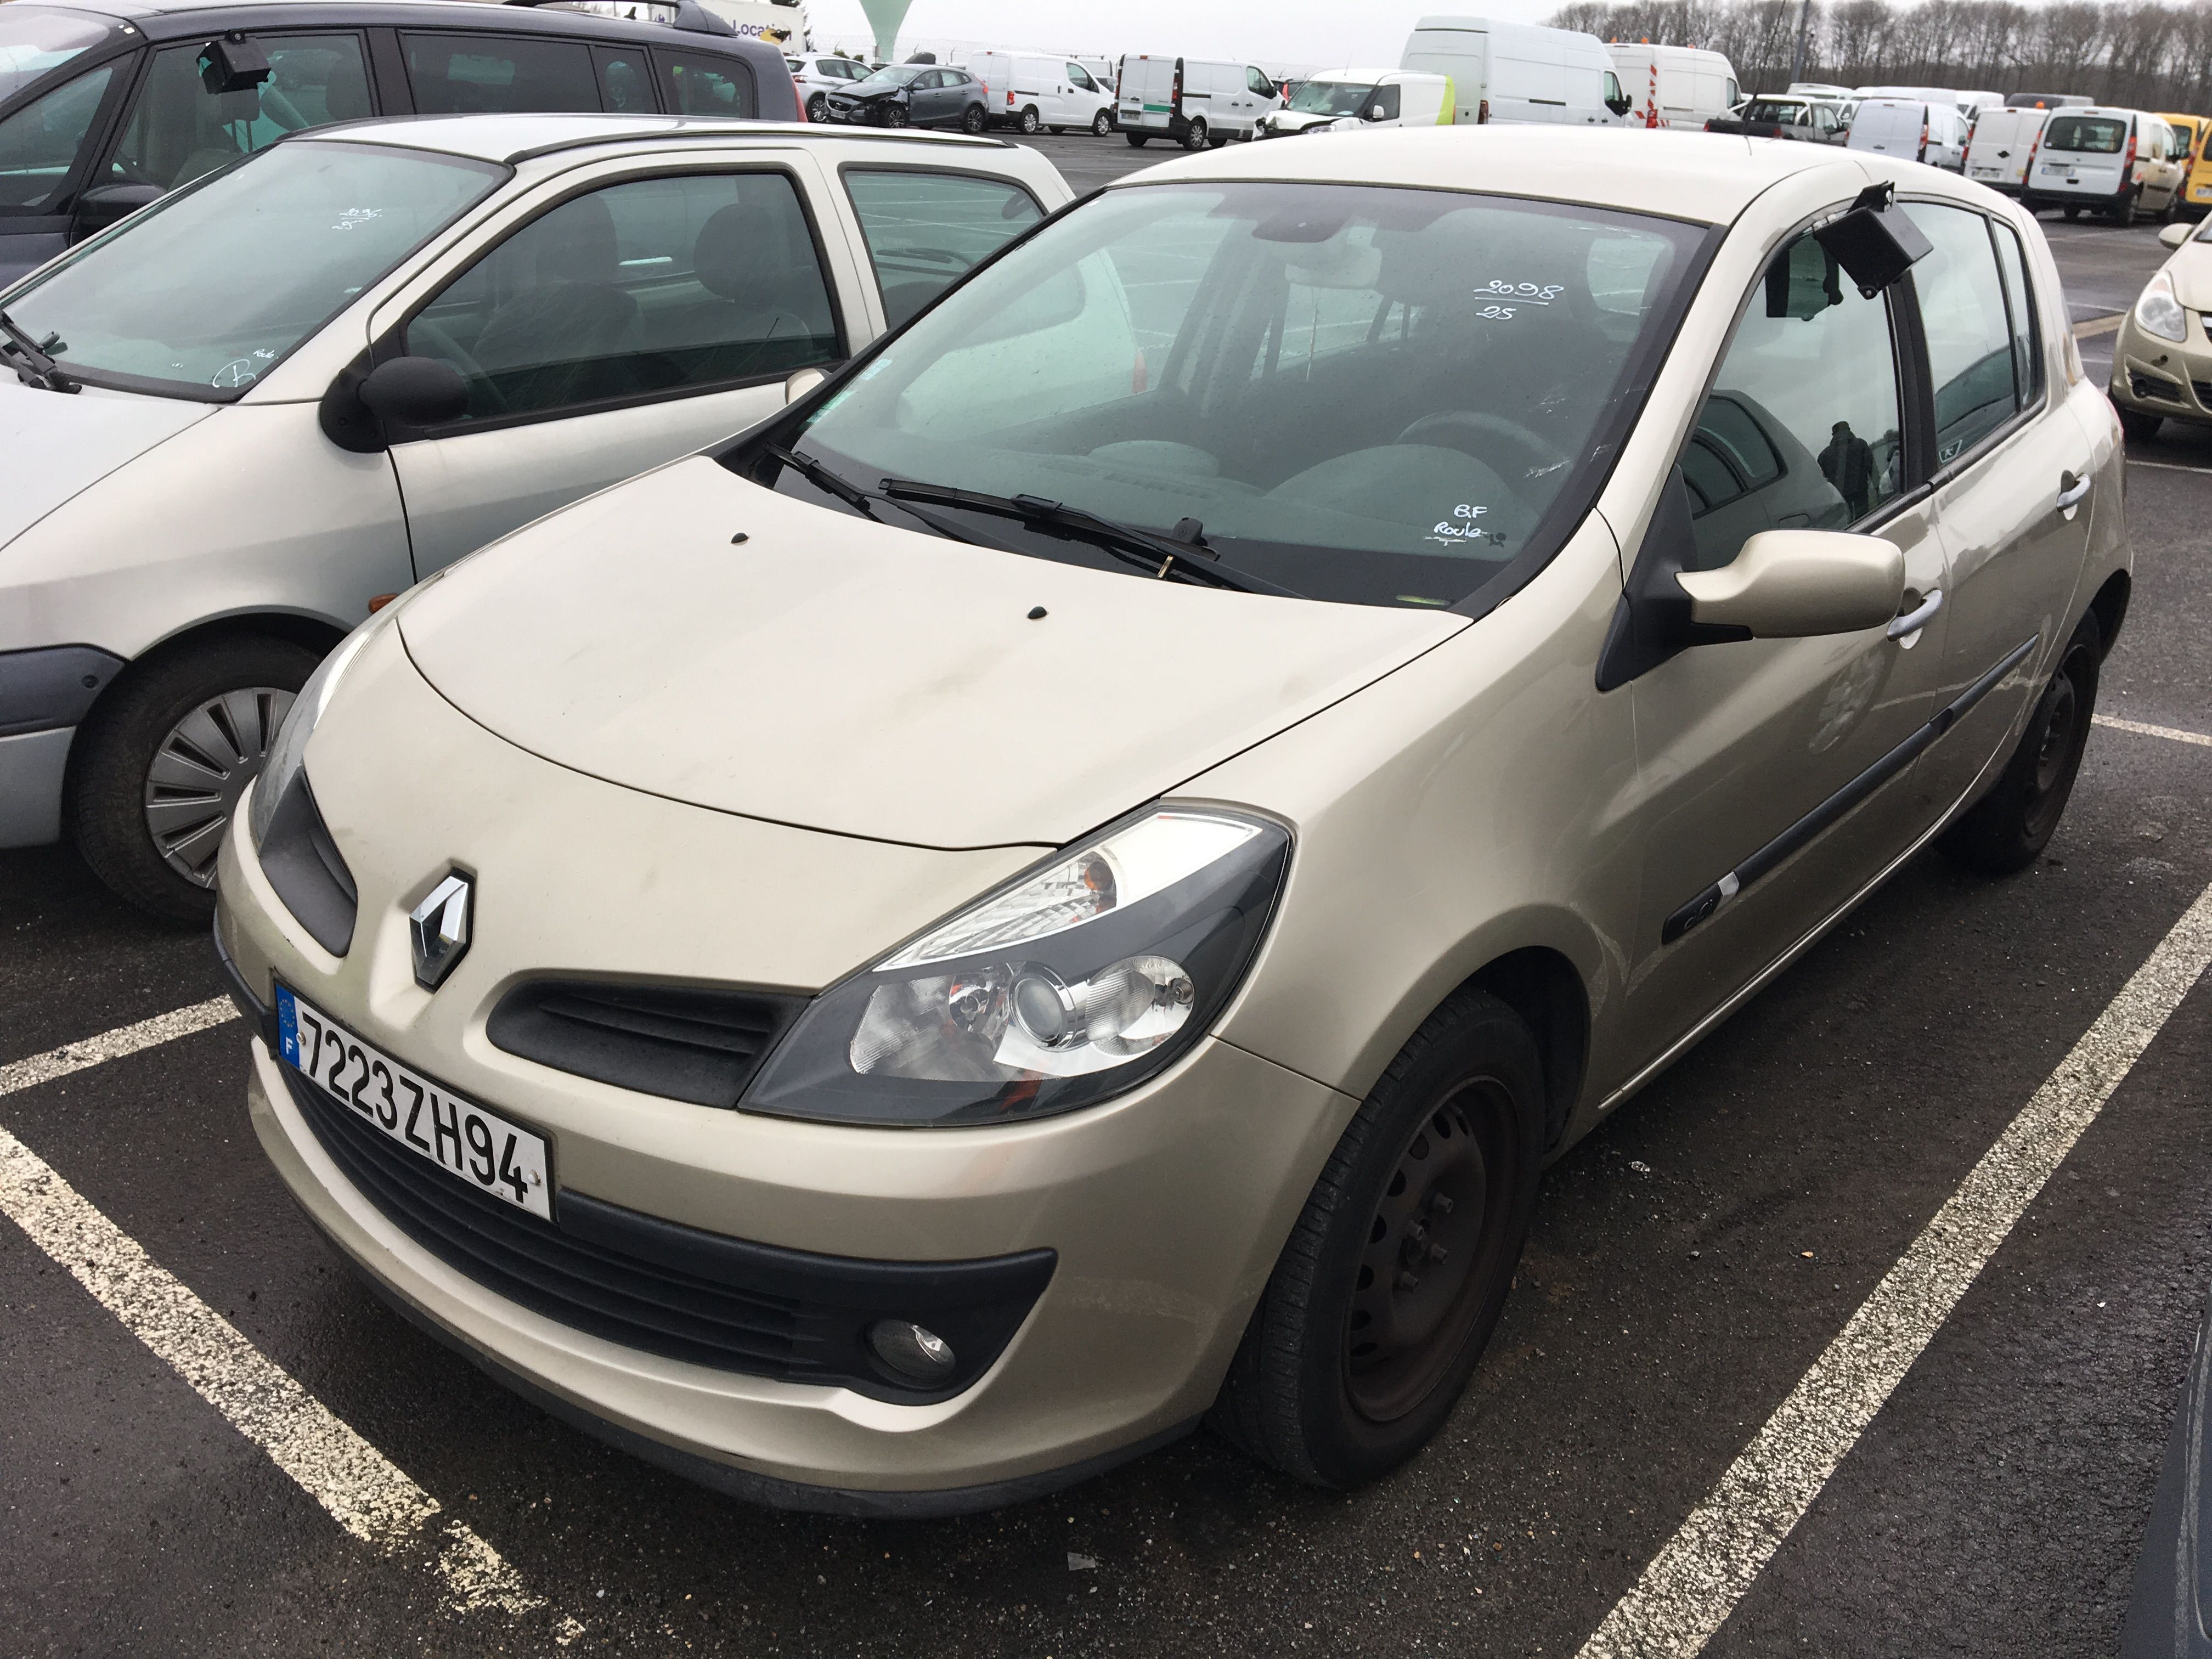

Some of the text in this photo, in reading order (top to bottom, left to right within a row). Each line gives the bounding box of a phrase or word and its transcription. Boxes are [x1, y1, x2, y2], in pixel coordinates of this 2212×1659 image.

[1473, 280, 1564, 300] 2098
[1475, 306, 1517, 320] 25
[1434, 521, 1482, 538] Roule
[286, 1036, 294, 1054] F
[302, 1011, 528, 1204] 7223ZH94
